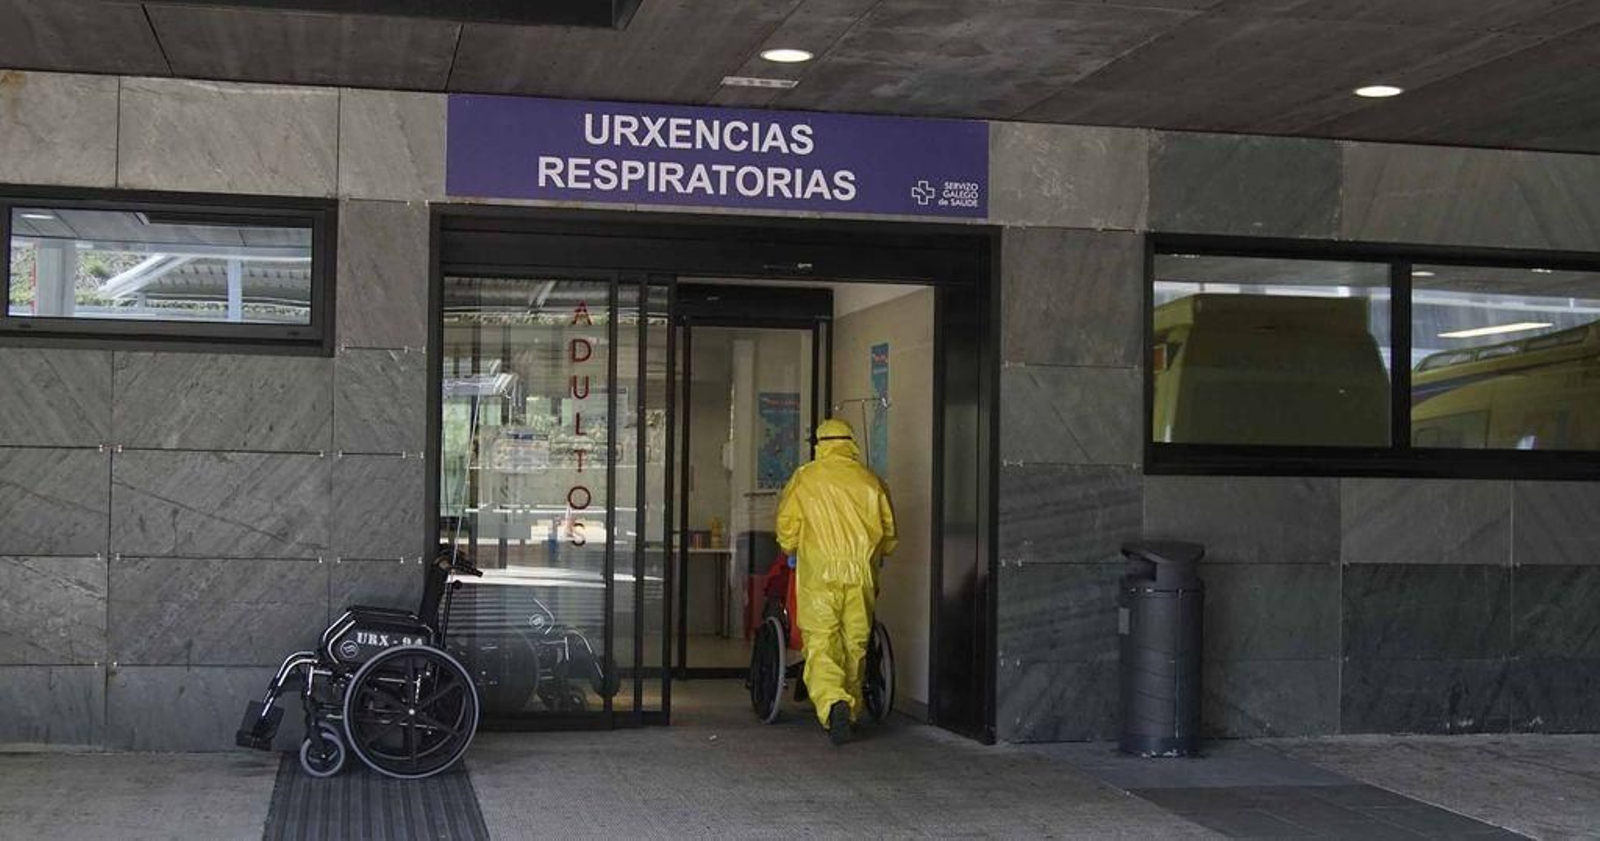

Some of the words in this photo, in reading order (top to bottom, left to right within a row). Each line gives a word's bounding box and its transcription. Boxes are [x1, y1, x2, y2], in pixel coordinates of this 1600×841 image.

[584, 113, 814, 155] URXENCIAS
[538, 156, 856, 201] RESPIRATORIAS
[944, 182, 978, 191] SERVIZO
[943, 190, 978, 198] GALEGO
[567, 301, 592, 546] ADULTOS
[357, 632, 389, 647] URX
